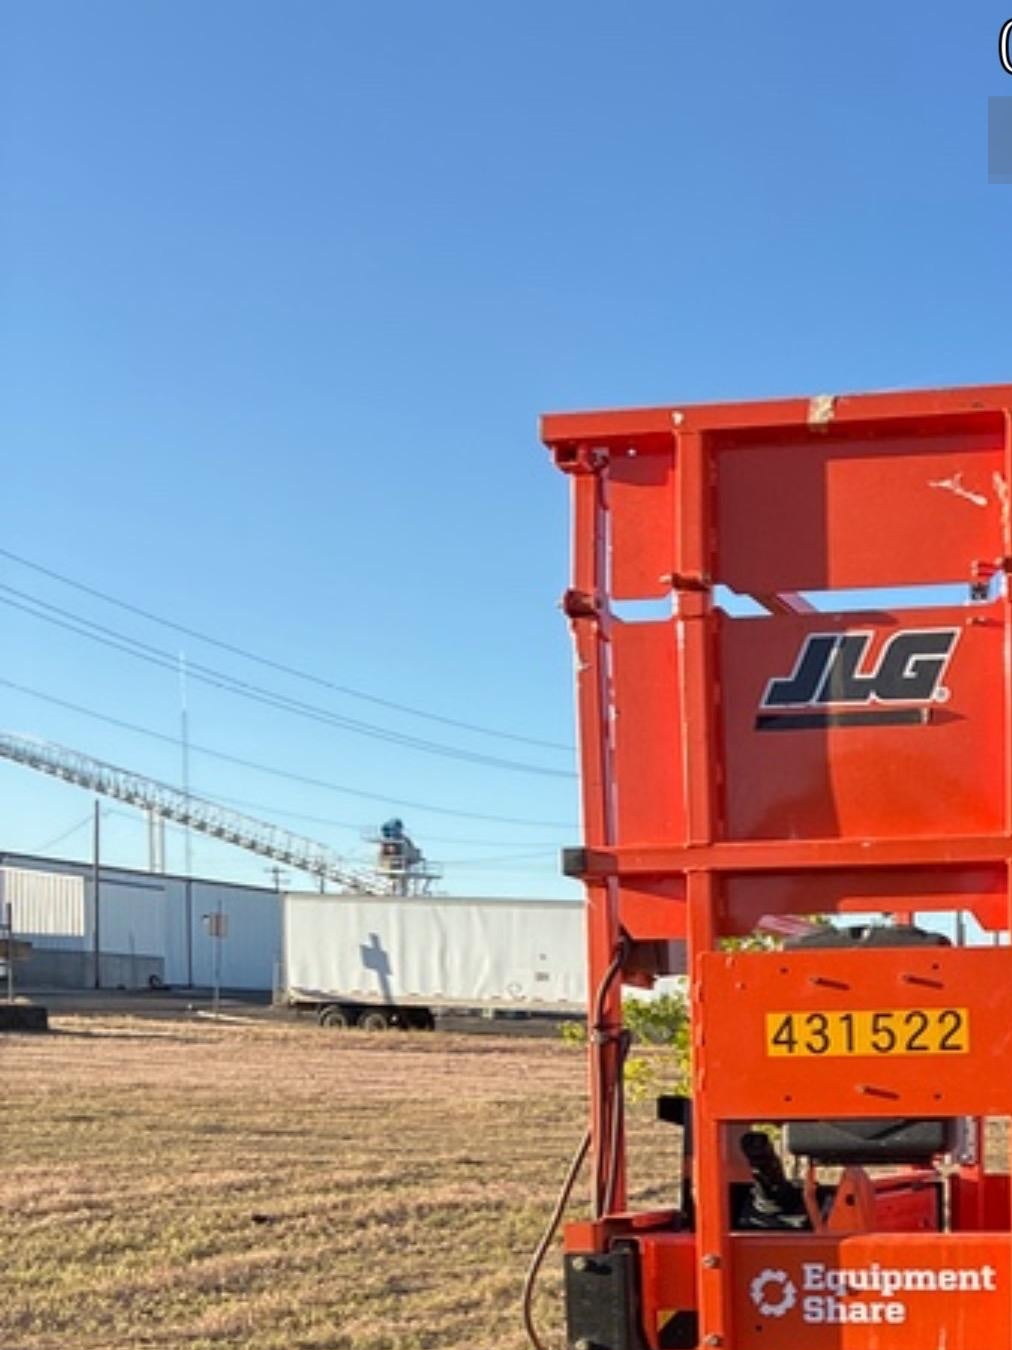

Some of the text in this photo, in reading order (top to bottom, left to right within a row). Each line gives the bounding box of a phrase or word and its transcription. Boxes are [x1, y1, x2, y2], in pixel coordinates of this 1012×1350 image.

[759, 627, 961, 708] JLG
[772, 1010, 963, 1053] 431522
[803, 1263, 996, 1297] Equipment
[803, 1296, 905, 1323] Share
